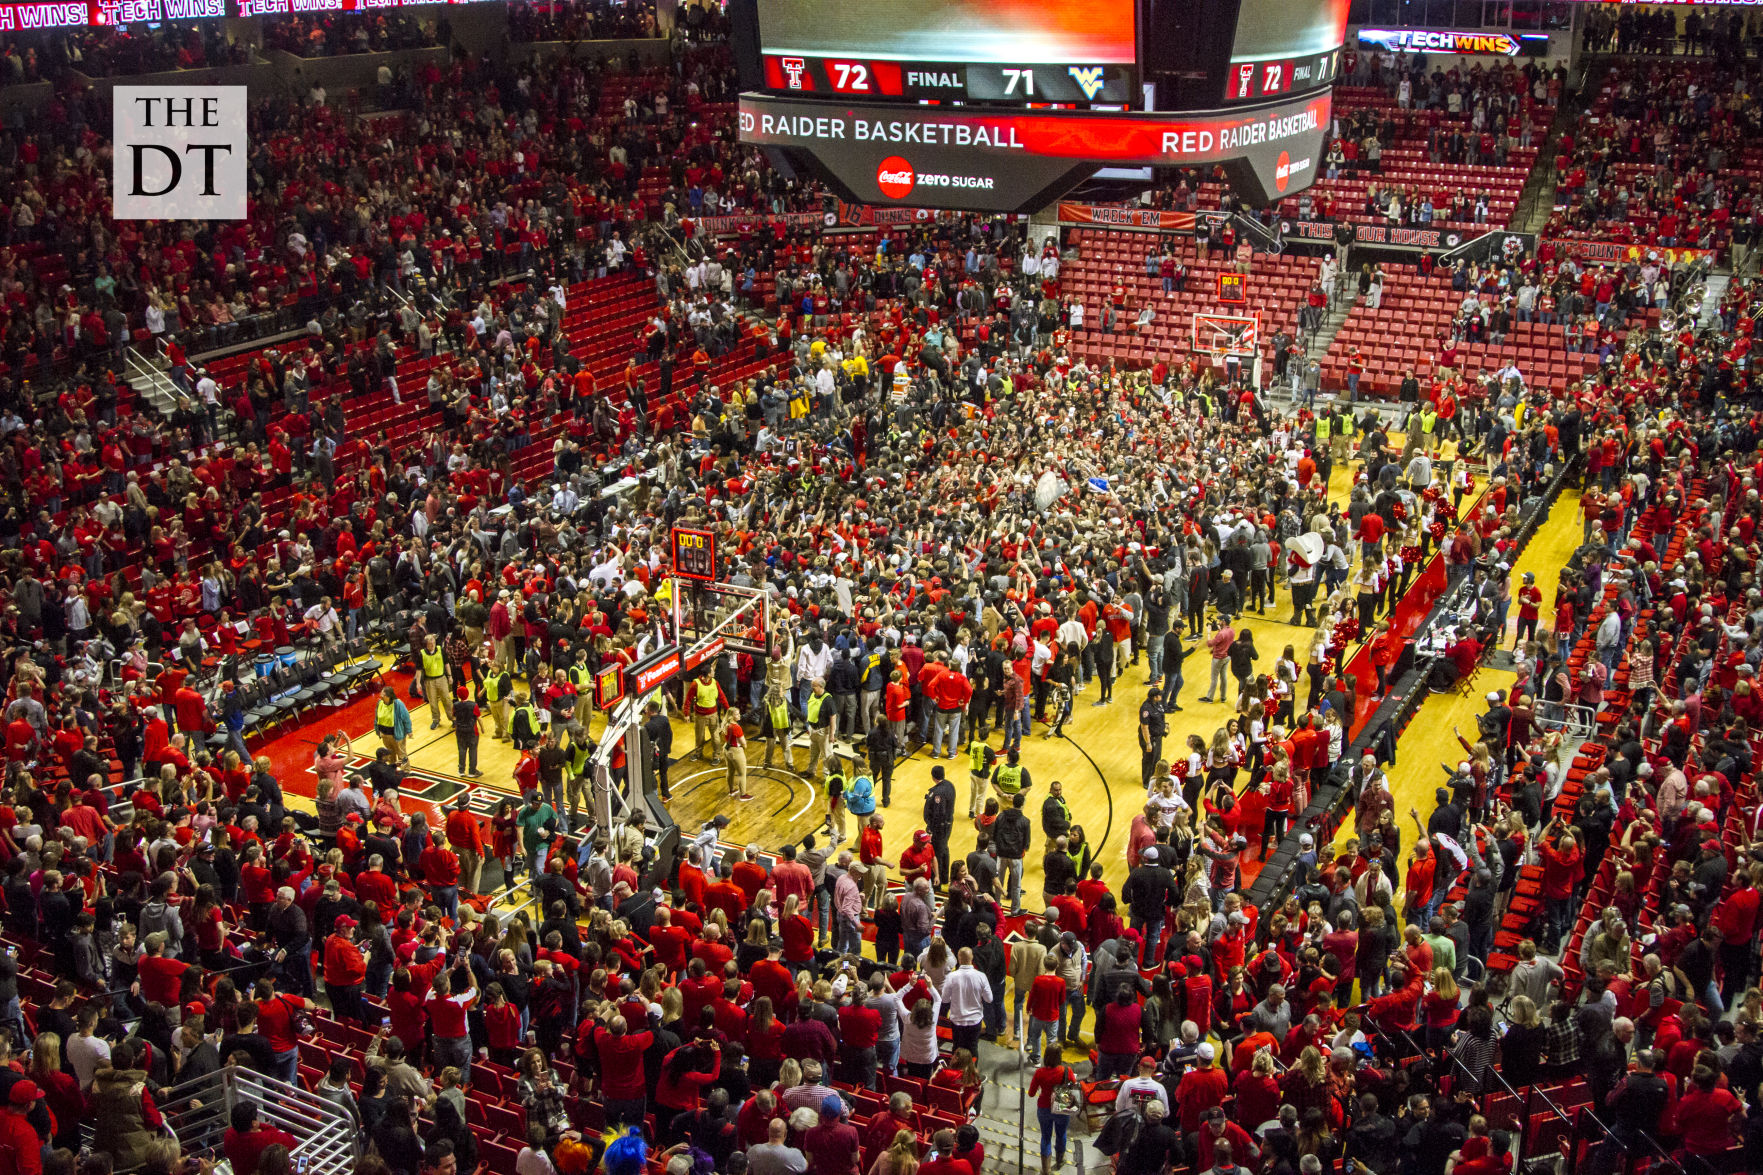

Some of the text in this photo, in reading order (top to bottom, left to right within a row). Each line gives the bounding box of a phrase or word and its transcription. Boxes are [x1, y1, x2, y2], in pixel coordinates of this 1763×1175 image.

[18, 3, 88, 28] WINS!
[165, 0, 225, 19] WINS!
[834, 64, 868, 89] 72
[908, 72, 963, 87] FINAL
[1002, 69, 1033, 95] 71
[1264, 65, 1281, 91] 72
[1294, 65, 1310, 80] FINAL
[1317, 57, 1328, 80] 71
[762, 115, 845, 139] RAIDER
[855, 119, 1024, 148] BASKETBALL
[1162, 109, 1318, 153] RED RAIDER BASKETBALL
[917, 173, 950, 187] zero
[952, 175, 994, 189] SUGAR
[874, 209, 911, 224] DUNKS
[1091, 208, 1133, 224] WRECK
[1297, 221, 1333, 239] THIS
[1356, 226, 1386, 242] OUR
[1390, 228, 1440, 247] HOUSE
[1057, 334, 1065, 343] 15
[1274, 436, 1281, 445] 16
